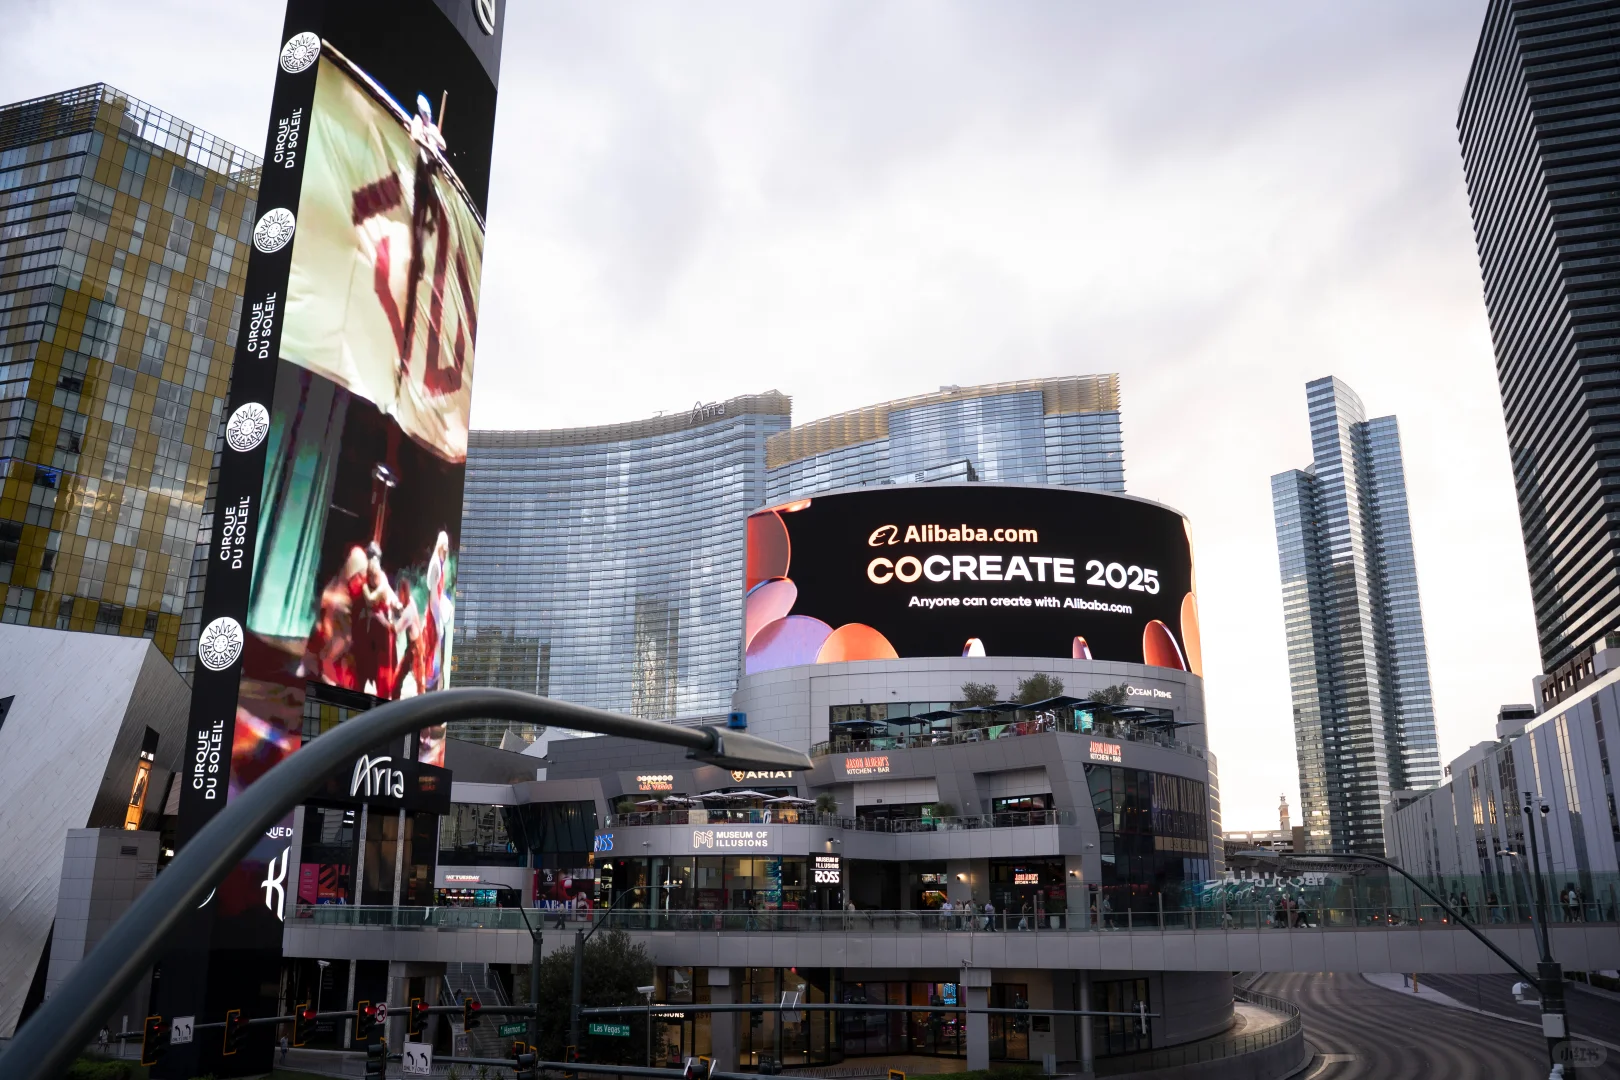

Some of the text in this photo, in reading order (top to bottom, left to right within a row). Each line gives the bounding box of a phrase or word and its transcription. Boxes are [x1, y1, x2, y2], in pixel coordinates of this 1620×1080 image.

[273, 117, 291, 163] CIRQUE
[284, 107, 303, 169] DU SOLEIL
[247, 302, 264, 352] CIRQUE
[258, 291, 276, 359] DU SOLEIL
[219, 506, 238, 561] CIRQUE
[231, 495, 250, 570] DU SOLEIL
[903, 524, 1038, 543] Alibaba.com
[867, 554, 1160, 595] COCREATE 2025
[908, 595, 1133, 615] Anyone can create with Alibaba.com
[1126, 686, 1152, 697] OCEAN
[192, 730, 211, 790] CIRQUE
[205, 719, 224, 800] DU SOLEIL
[350, 753, 405, 799] Aria
[846, 767, 872, 775] KITCHEN
[716, 831, 768, 839] MUSEUM OF
[716, 839, 768, 847] ILLUSIONS
[815, 870, 840, 884] ROSS
[593, 1023, 603, 1033] Las
[603, 1023, 621, 1036] Vegas
